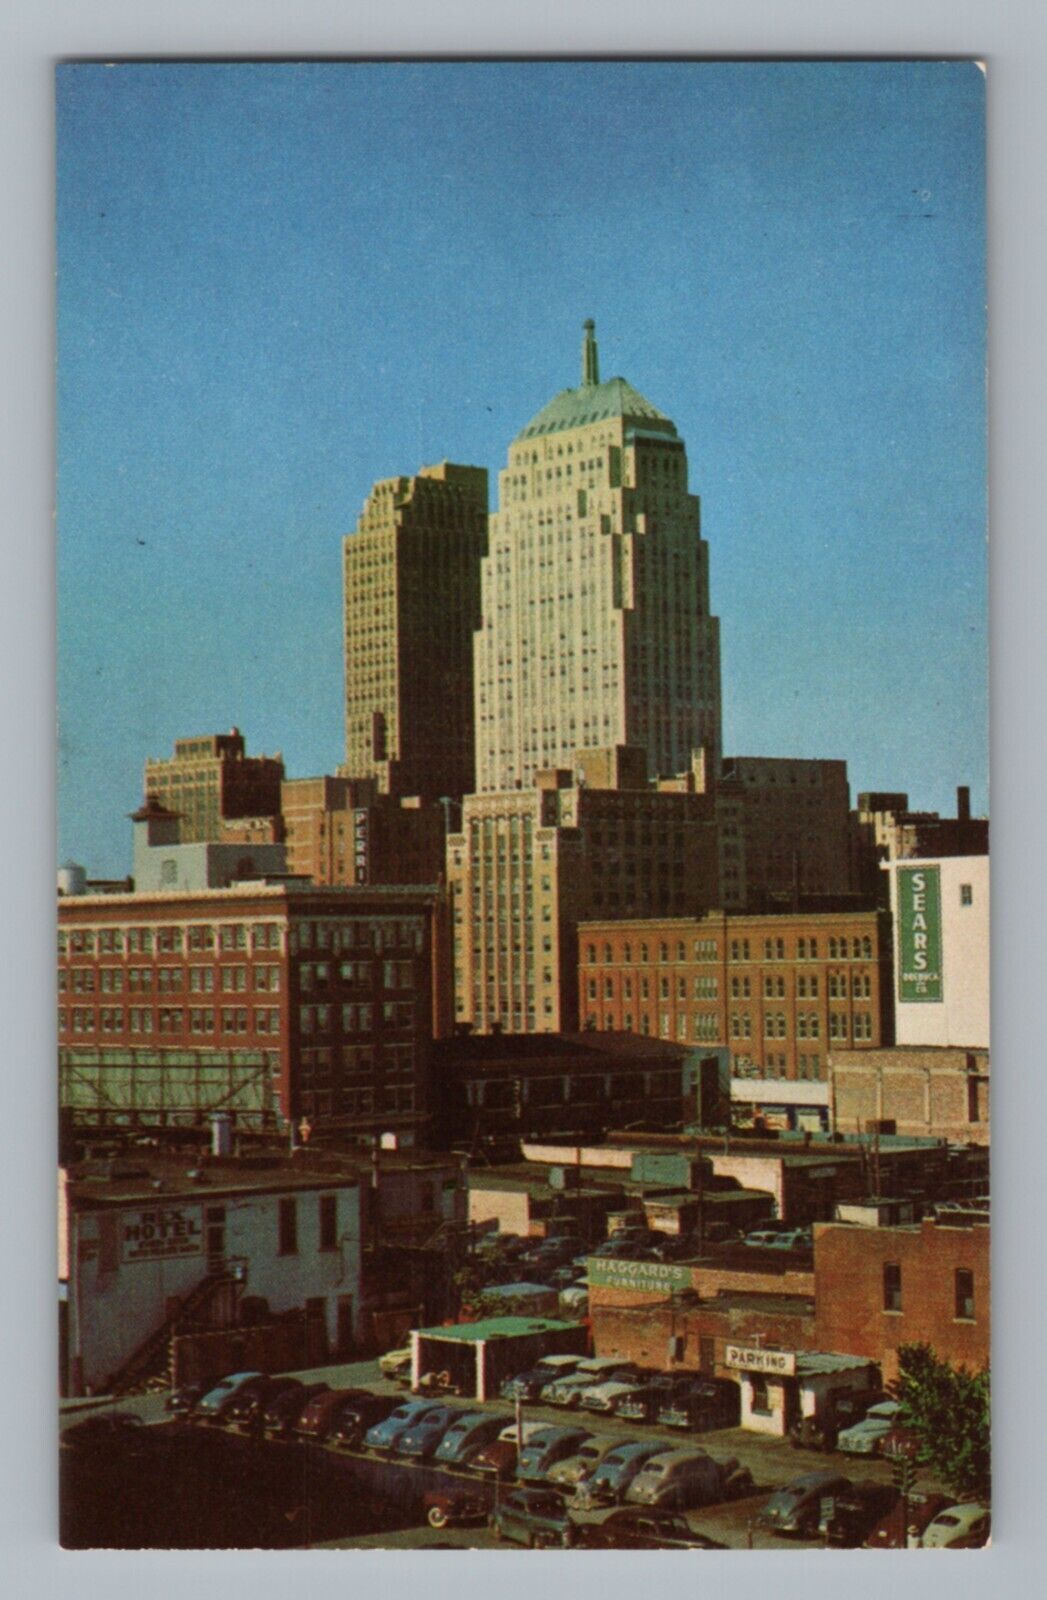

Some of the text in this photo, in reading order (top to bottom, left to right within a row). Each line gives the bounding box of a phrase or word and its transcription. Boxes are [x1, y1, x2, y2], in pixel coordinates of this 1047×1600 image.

[911, 872, 927, 970] SEARS
[124, 1219, 201, 1241] HOTEL
[595, 1259, 683, 1280] HAGGARD'S
[606, 1275, 672, 1291] FURNITURE
[731, 1349, 787, 1370] PARKING
